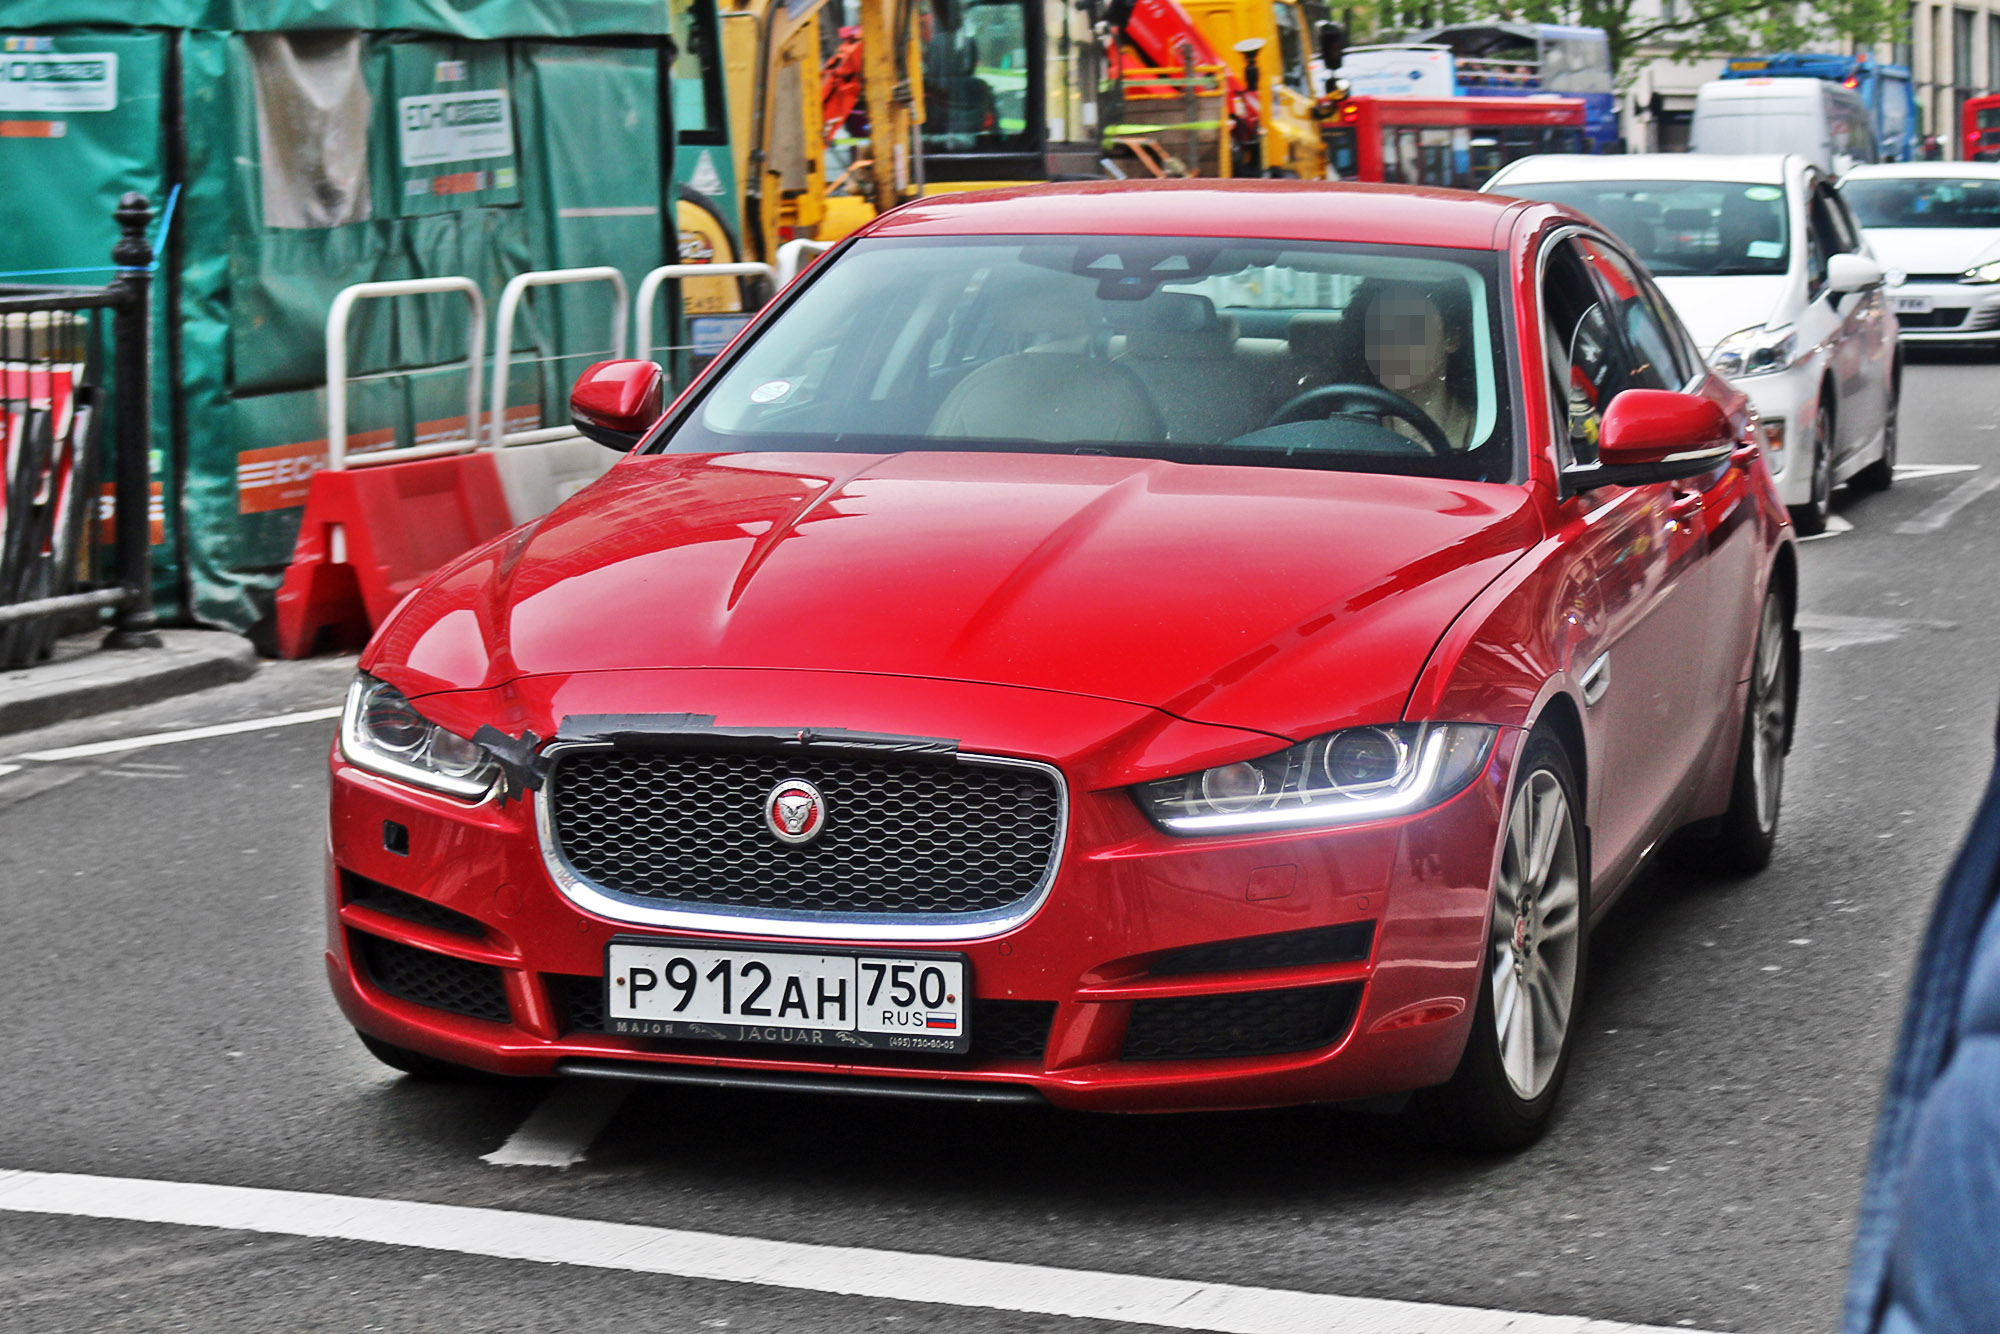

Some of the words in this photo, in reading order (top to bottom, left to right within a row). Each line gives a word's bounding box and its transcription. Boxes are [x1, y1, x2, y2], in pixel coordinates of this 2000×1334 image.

[630, 957, 846, 1021] P912AH
[861, 963, 946, 1009] 750
[882, 1010, 924, 1026] RUS
[617, 1021, 674, 1034] MAJOR
[738, 1027, 823, 1044] JAGUAR
[889, 1036, 911, 1048] (495)
